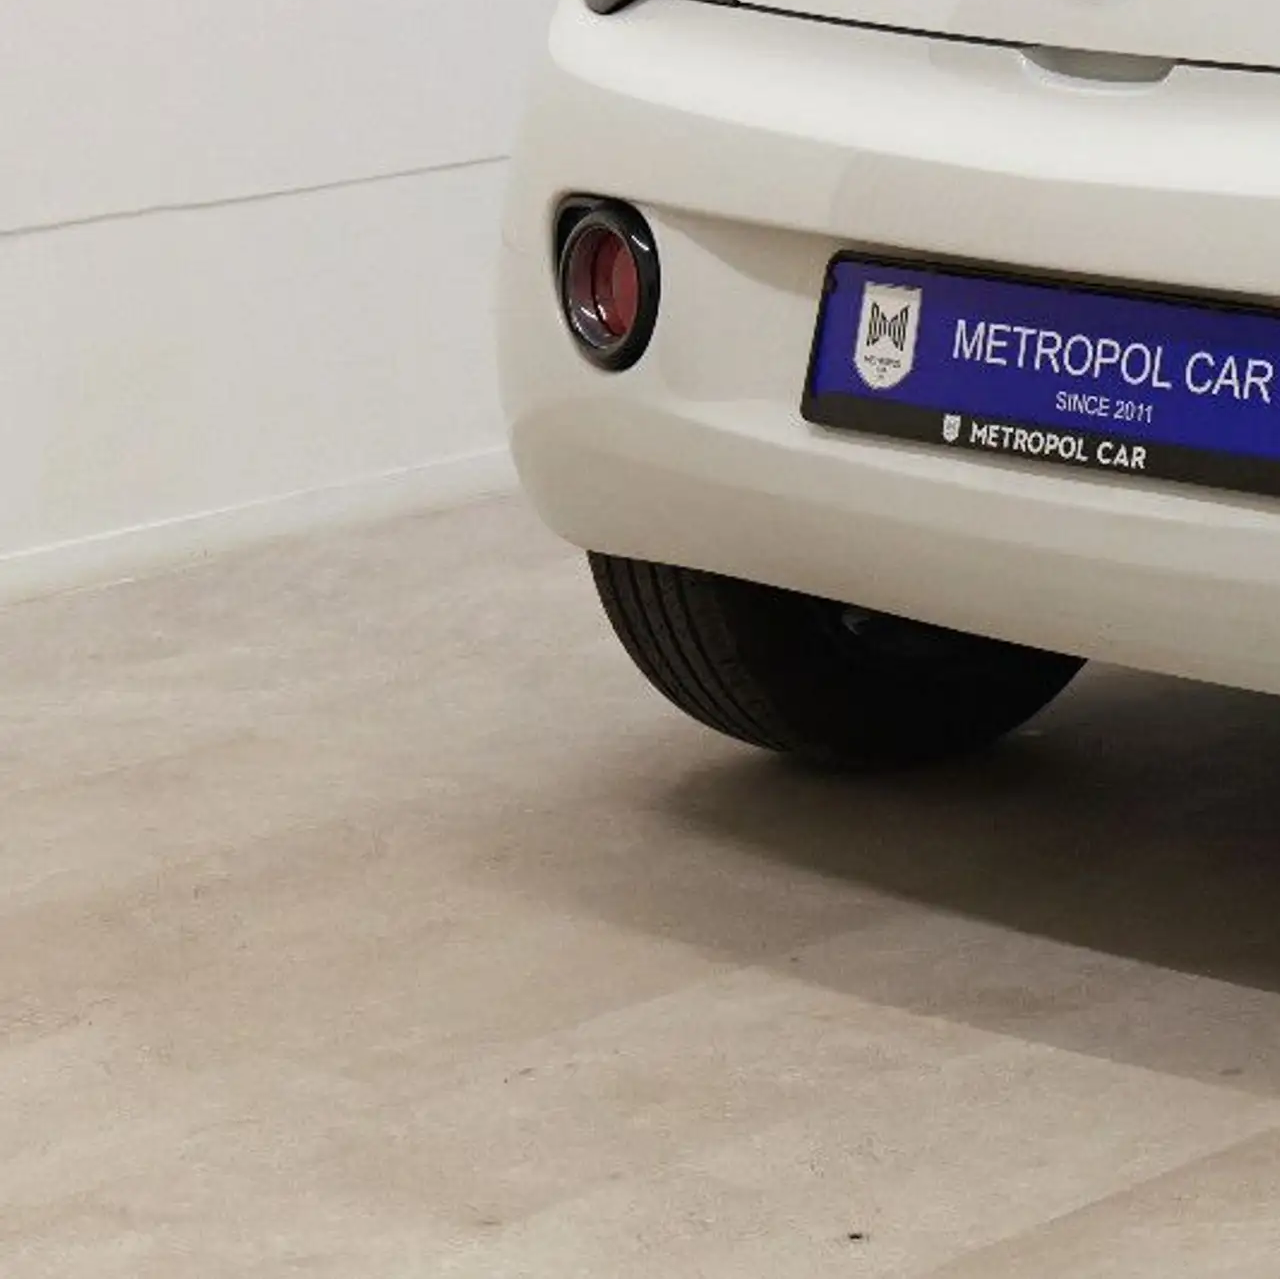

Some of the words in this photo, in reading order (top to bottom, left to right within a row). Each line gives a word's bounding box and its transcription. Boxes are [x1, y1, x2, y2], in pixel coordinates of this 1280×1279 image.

[952, 318, 1172, 390] METROPOL
[1184, 351, 1275, 404] CAR
[1055, 390, 1111, 418] SINCE
[1113, 400, 1153, 424] 2011
[969, 419, 1089, 463] METROPOL
[1096, 441, 1147, 470] CAR
